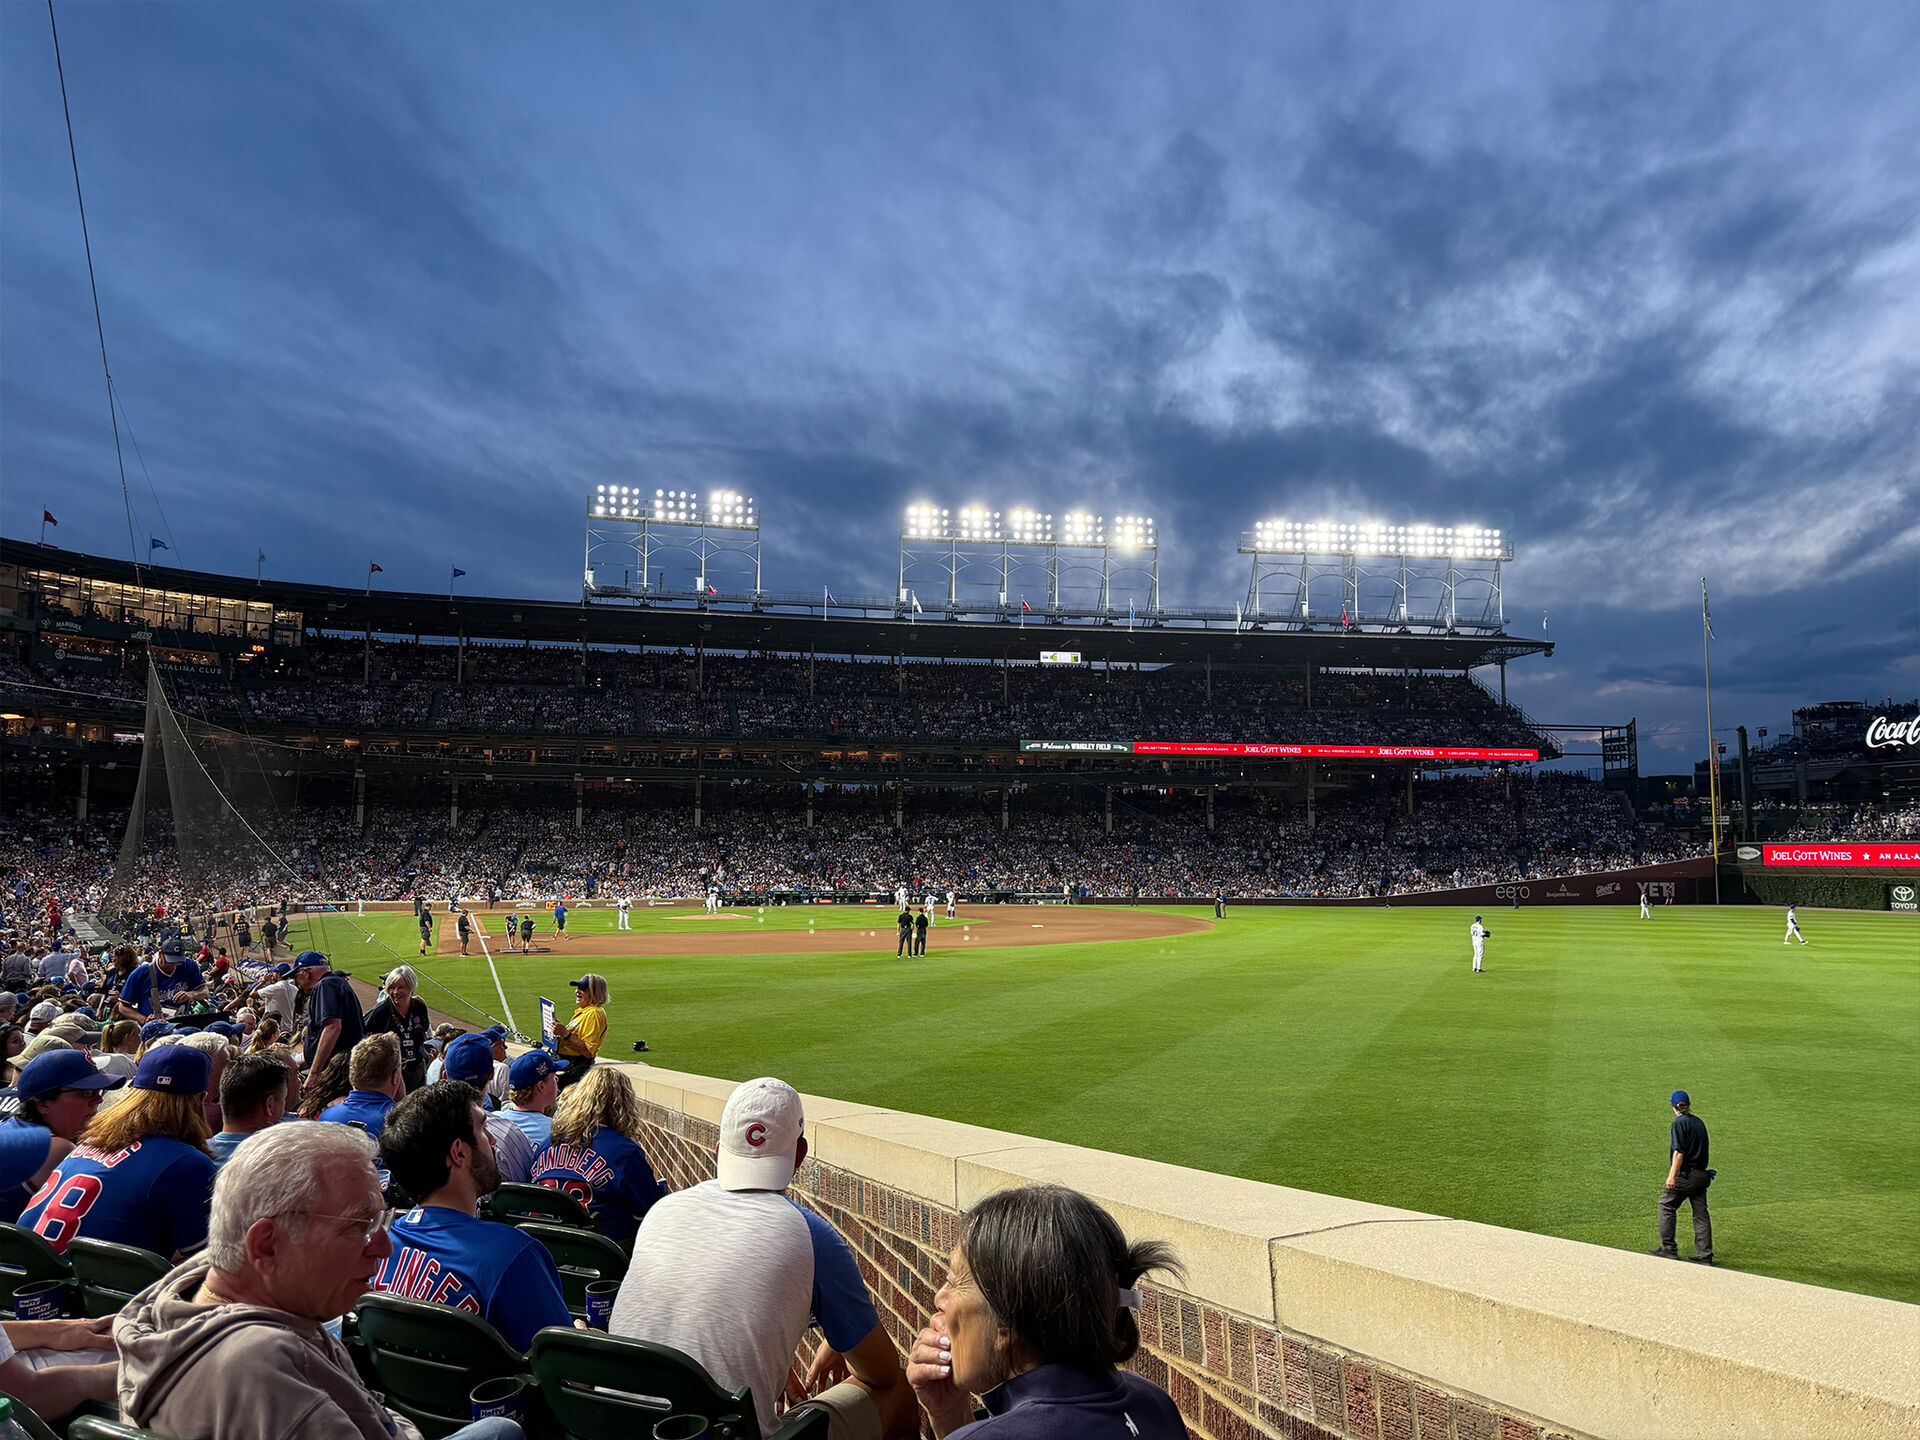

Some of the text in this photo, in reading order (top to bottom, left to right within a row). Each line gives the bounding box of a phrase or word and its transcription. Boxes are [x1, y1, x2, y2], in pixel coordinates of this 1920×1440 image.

[157, 663, 222, 675] ATALINA CLUB
[1096, 743, 1111, 751] FIELD
[1244, 745, 1260, 753] JOEL
[1378, 748, 1394, 756] JOEL
[1770, 850, 1852, 861] JOEL GOTT WINES
[1637, 882, 1675, 896] YETI
[746, 1124, 766, 1146] C
[19, 1299, 40, 1308] Hefty
[28, 1304, 51, 1314] Hefty
